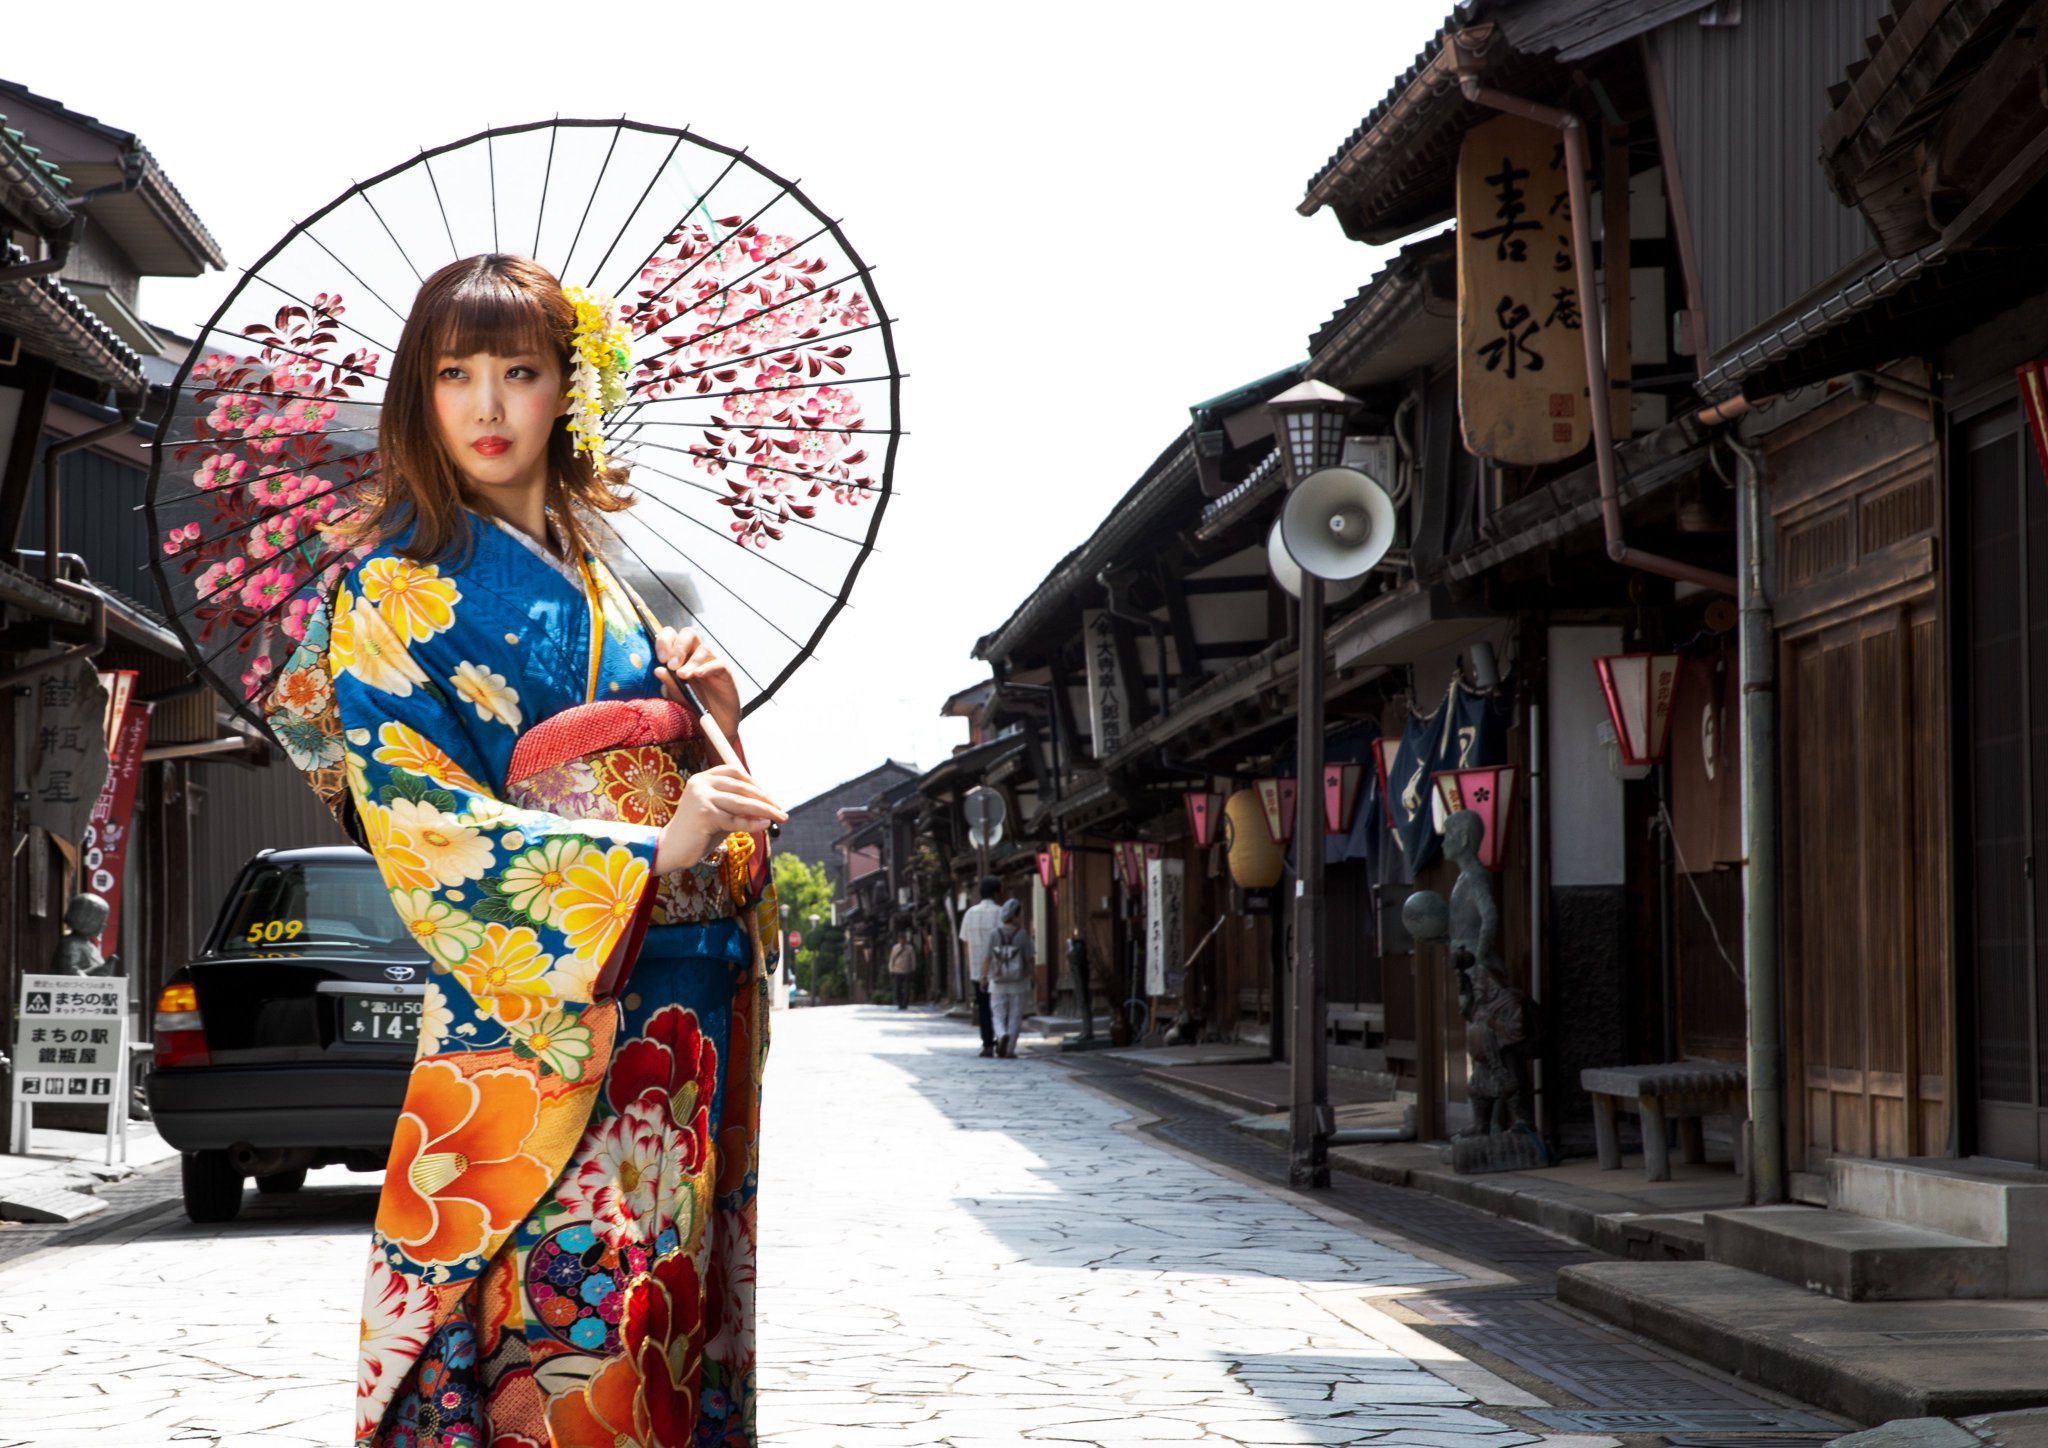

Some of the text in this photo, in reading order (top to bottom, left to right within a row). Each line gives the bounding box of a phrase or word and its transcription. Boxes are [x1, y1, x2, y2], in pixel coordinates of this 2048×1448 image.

[246, 920, 304, 943] 509
[55, 992, 118, 1006] まちの駅
[351, 1021, 365, 1032] あ
[31, 1027, 109, 1044] まちの駅
